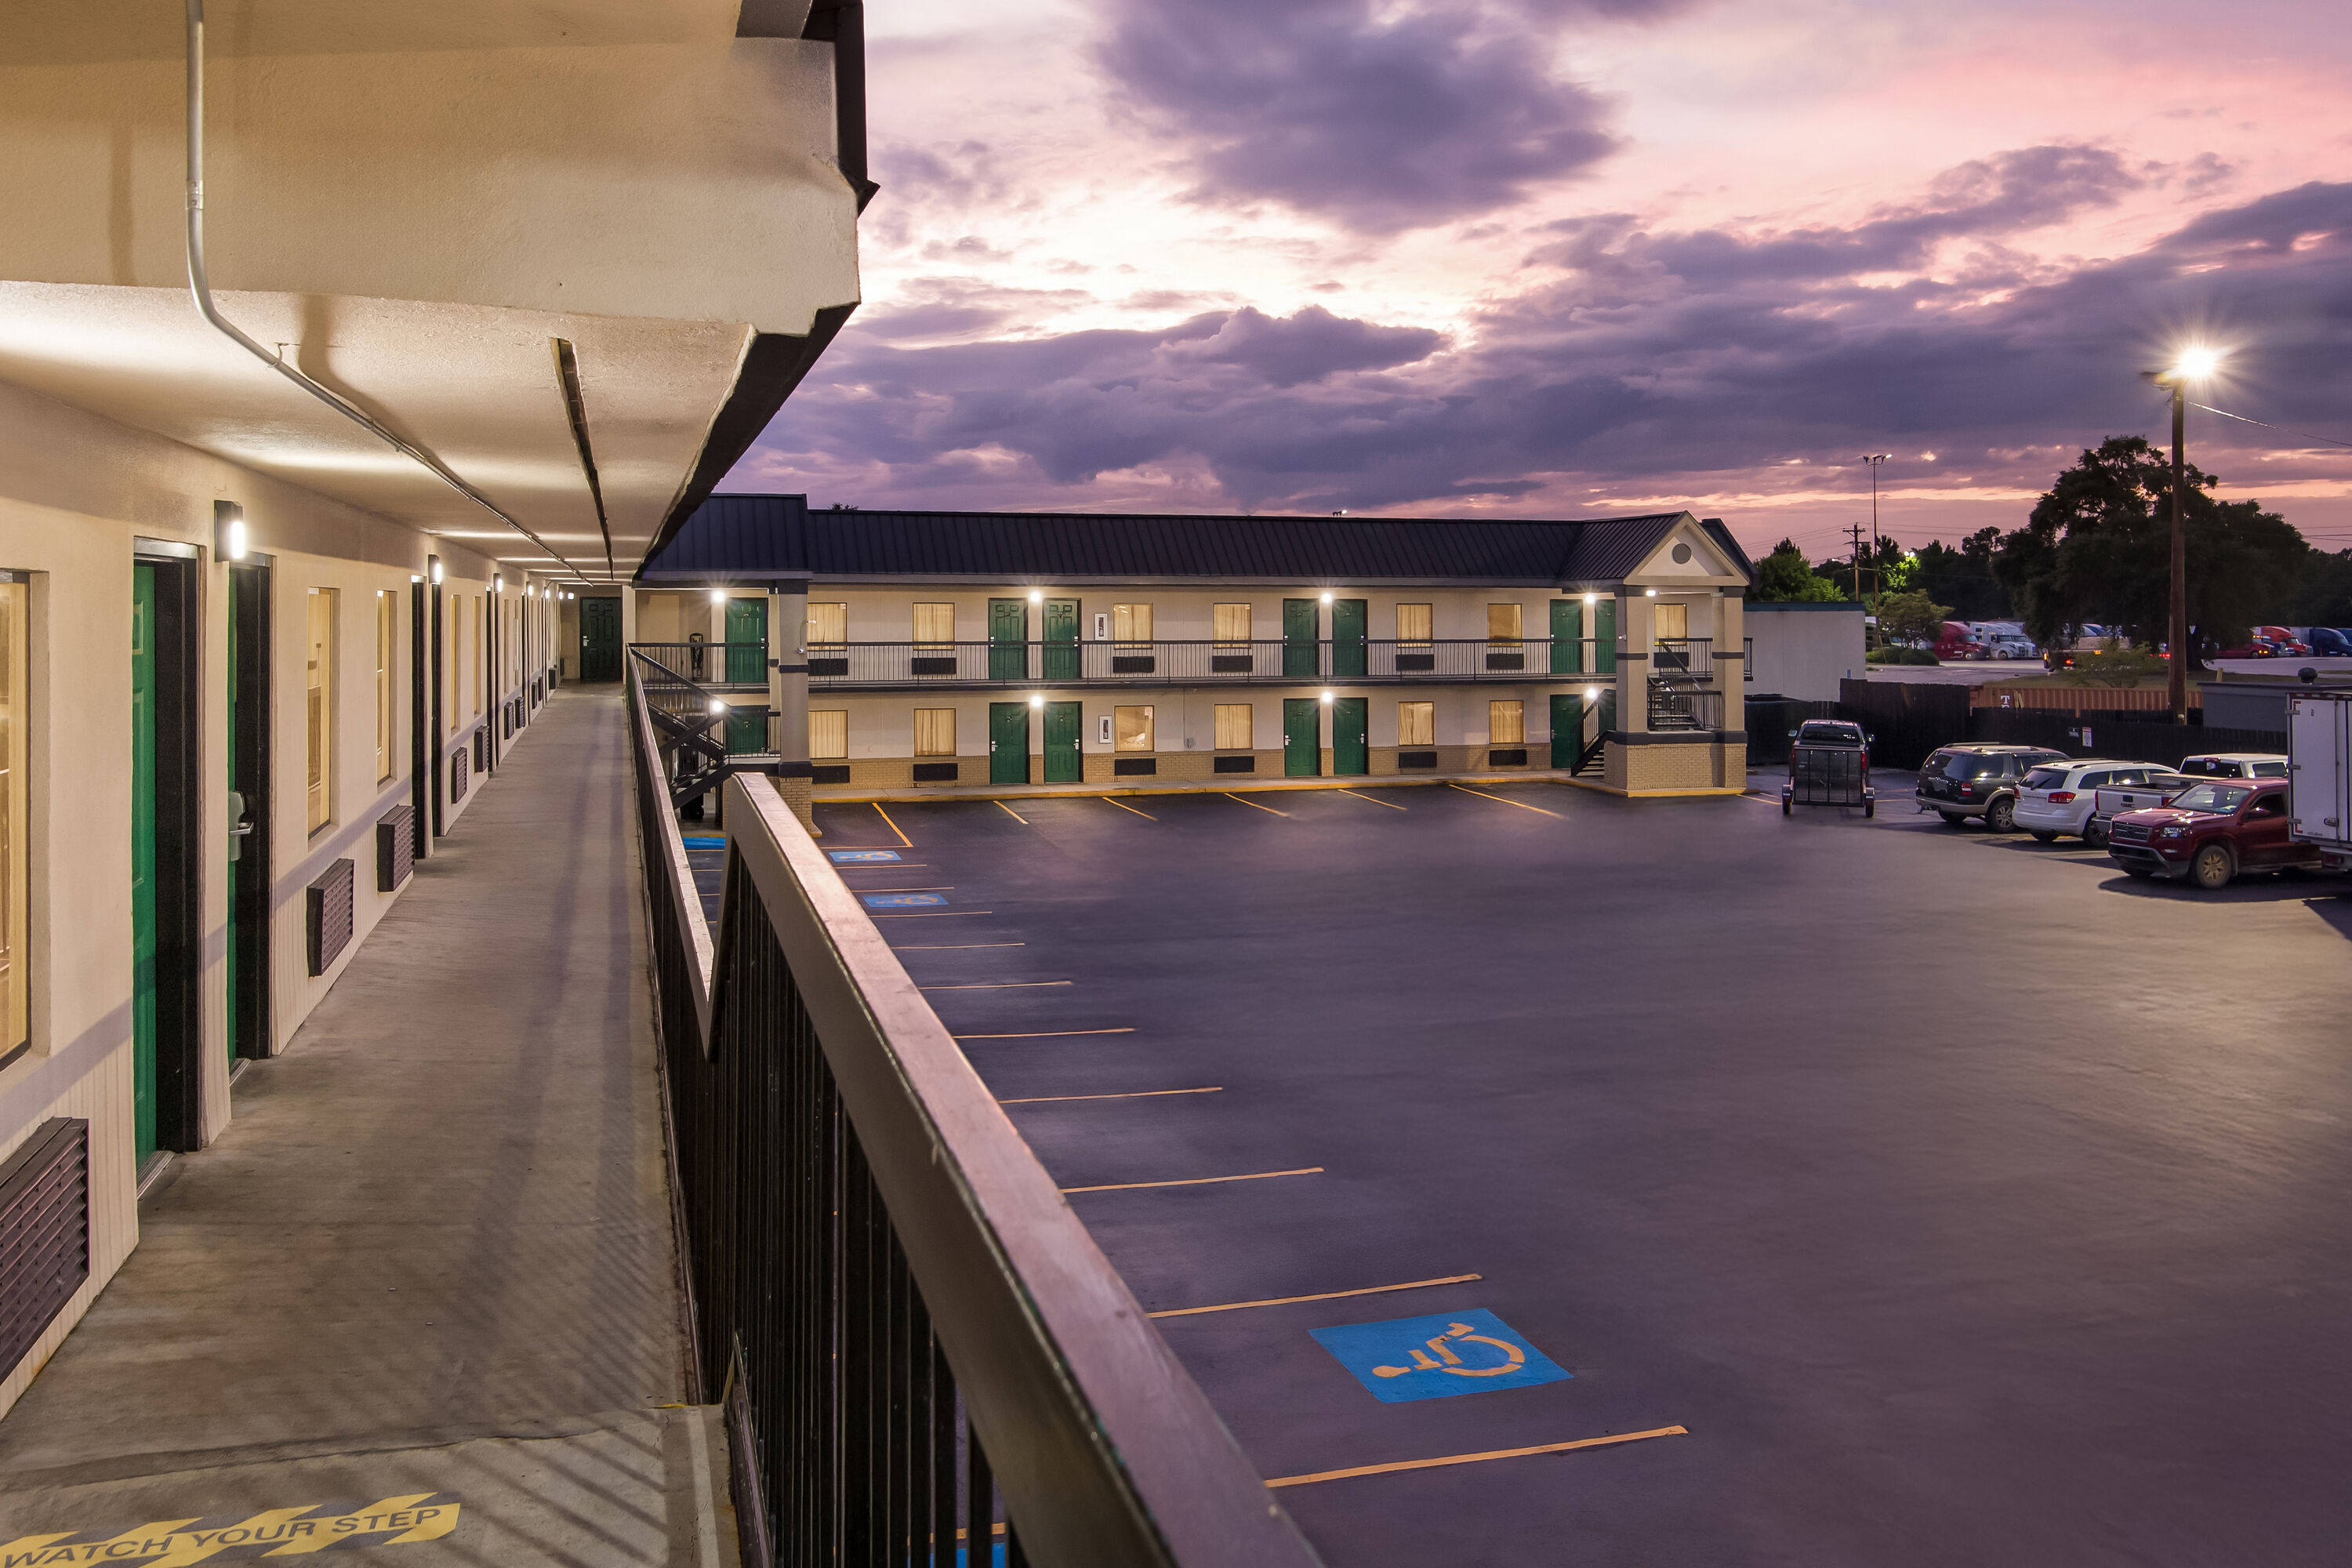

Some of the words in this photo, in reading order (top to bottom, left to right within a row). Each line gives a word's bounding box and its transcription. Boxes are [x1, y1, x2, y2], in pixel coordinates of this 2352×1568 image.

[4, 1535, 174, 1568] WATCH
[191, 1522, 317, 1548] YOUR
[331, 1508, 441, 1533] STEP
